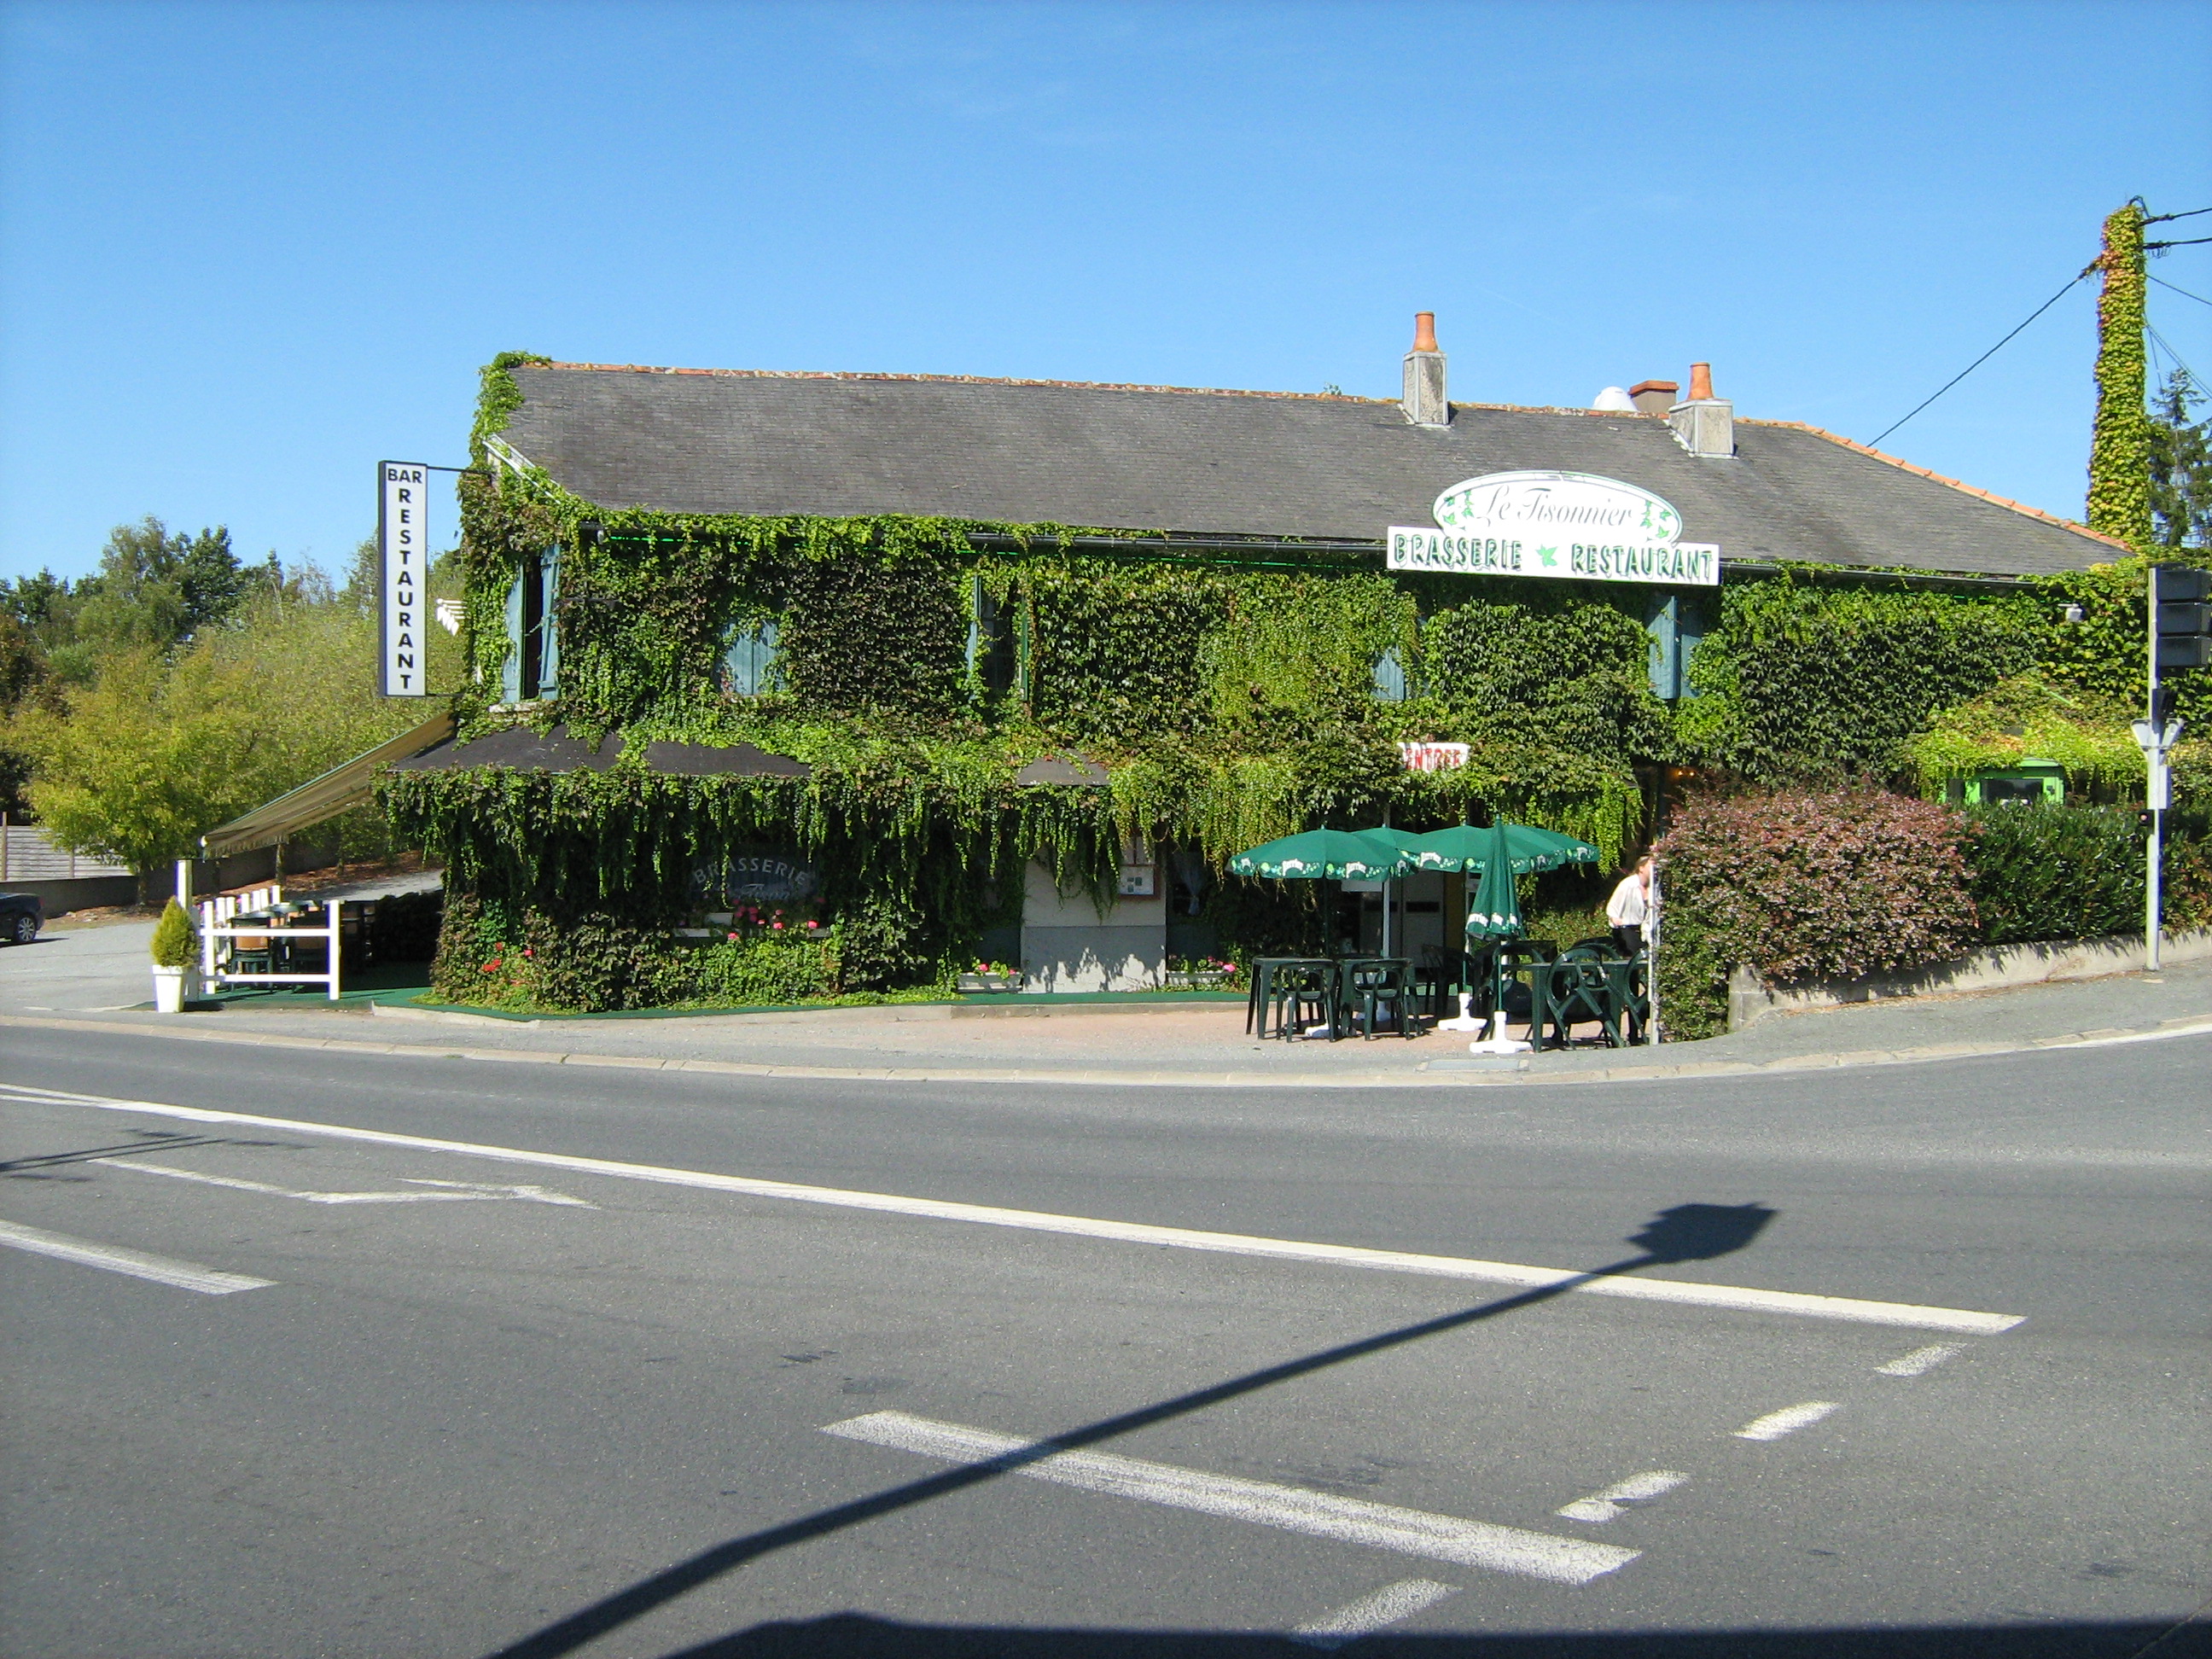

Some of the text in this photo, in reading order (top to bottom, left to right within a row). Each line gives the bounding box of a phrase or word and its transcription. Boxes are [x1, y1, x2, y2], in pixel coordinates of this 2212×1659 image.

[387, 468, 422, 484] BAR
[1476, 484, 1633, 527] Le Tisonnier
[1394, 533, 1714, 579] BRASSERIE RESTAURANT
[397, 487, 413, 690] RESTAURANT
[693, 857, 809, 886] BRASSERIE
